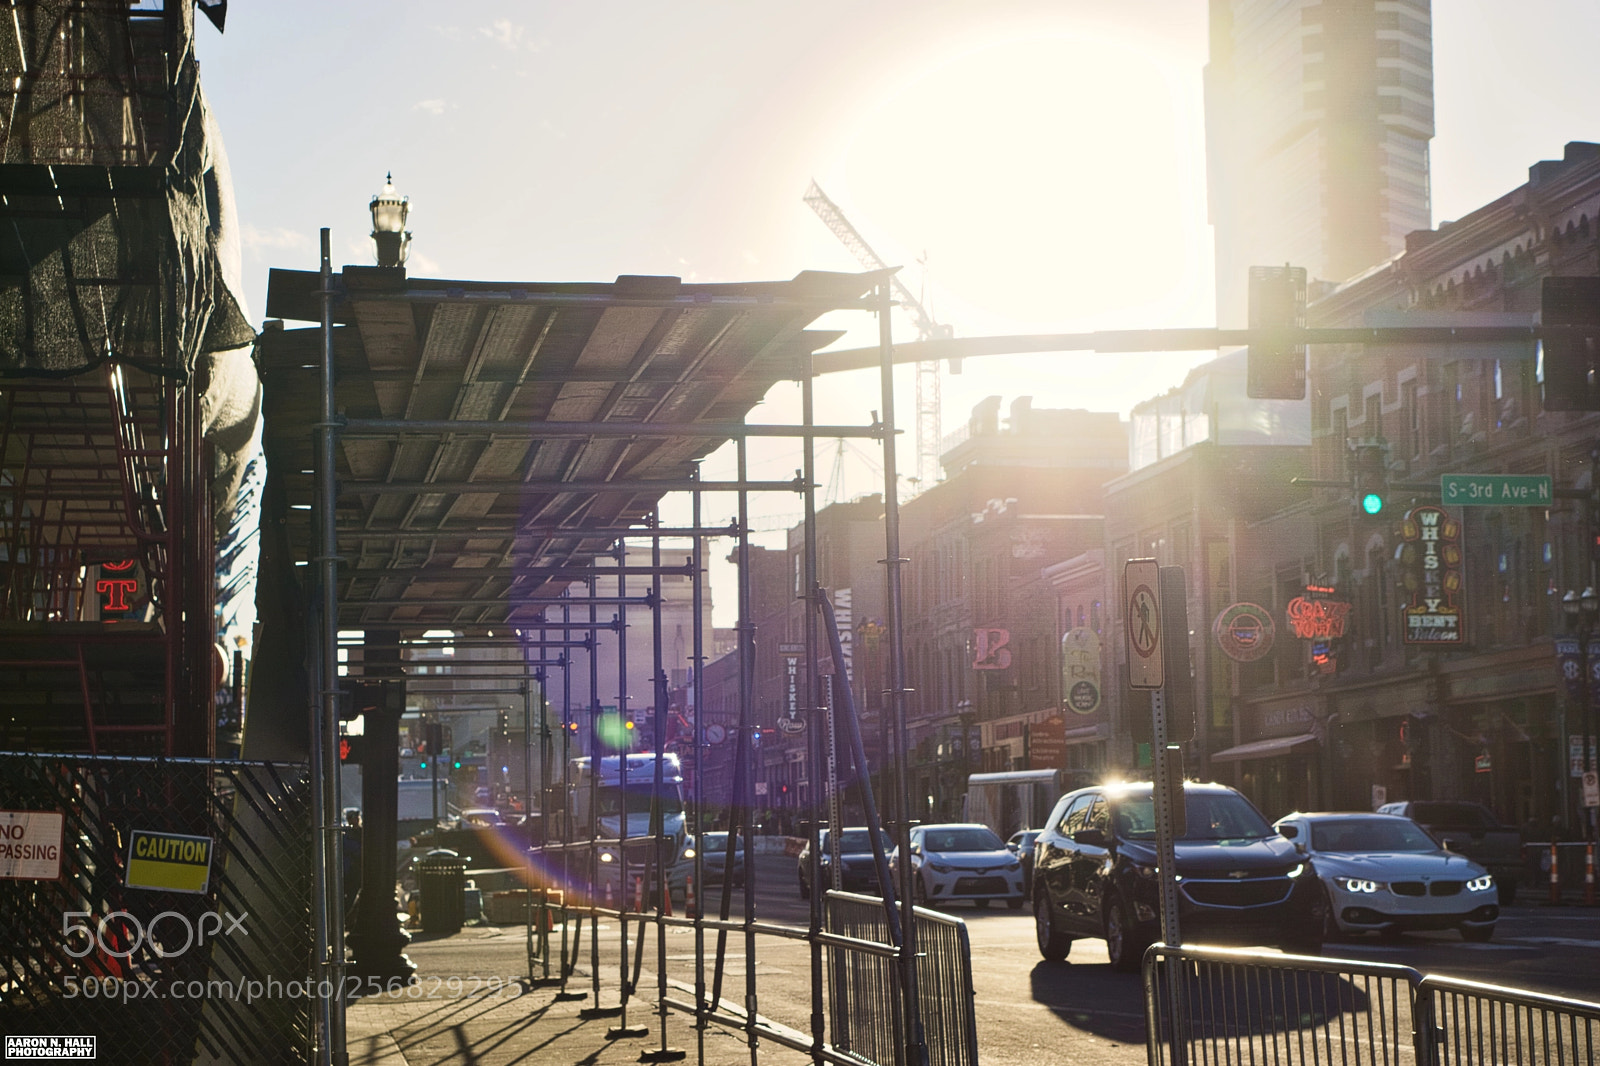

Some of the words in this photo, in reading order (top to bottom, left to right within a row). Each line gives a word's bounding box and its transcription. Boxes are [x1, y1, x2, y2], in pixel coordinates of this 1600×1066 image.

[1419, 512, 1441, 612] WHISKEY
[1408, 615, 1458, 628] BENT
[786, 657, 798, 720] WHISKEY
[0, 825, 24, 840] NO
[136, 836, 207, 863] CAUTION
